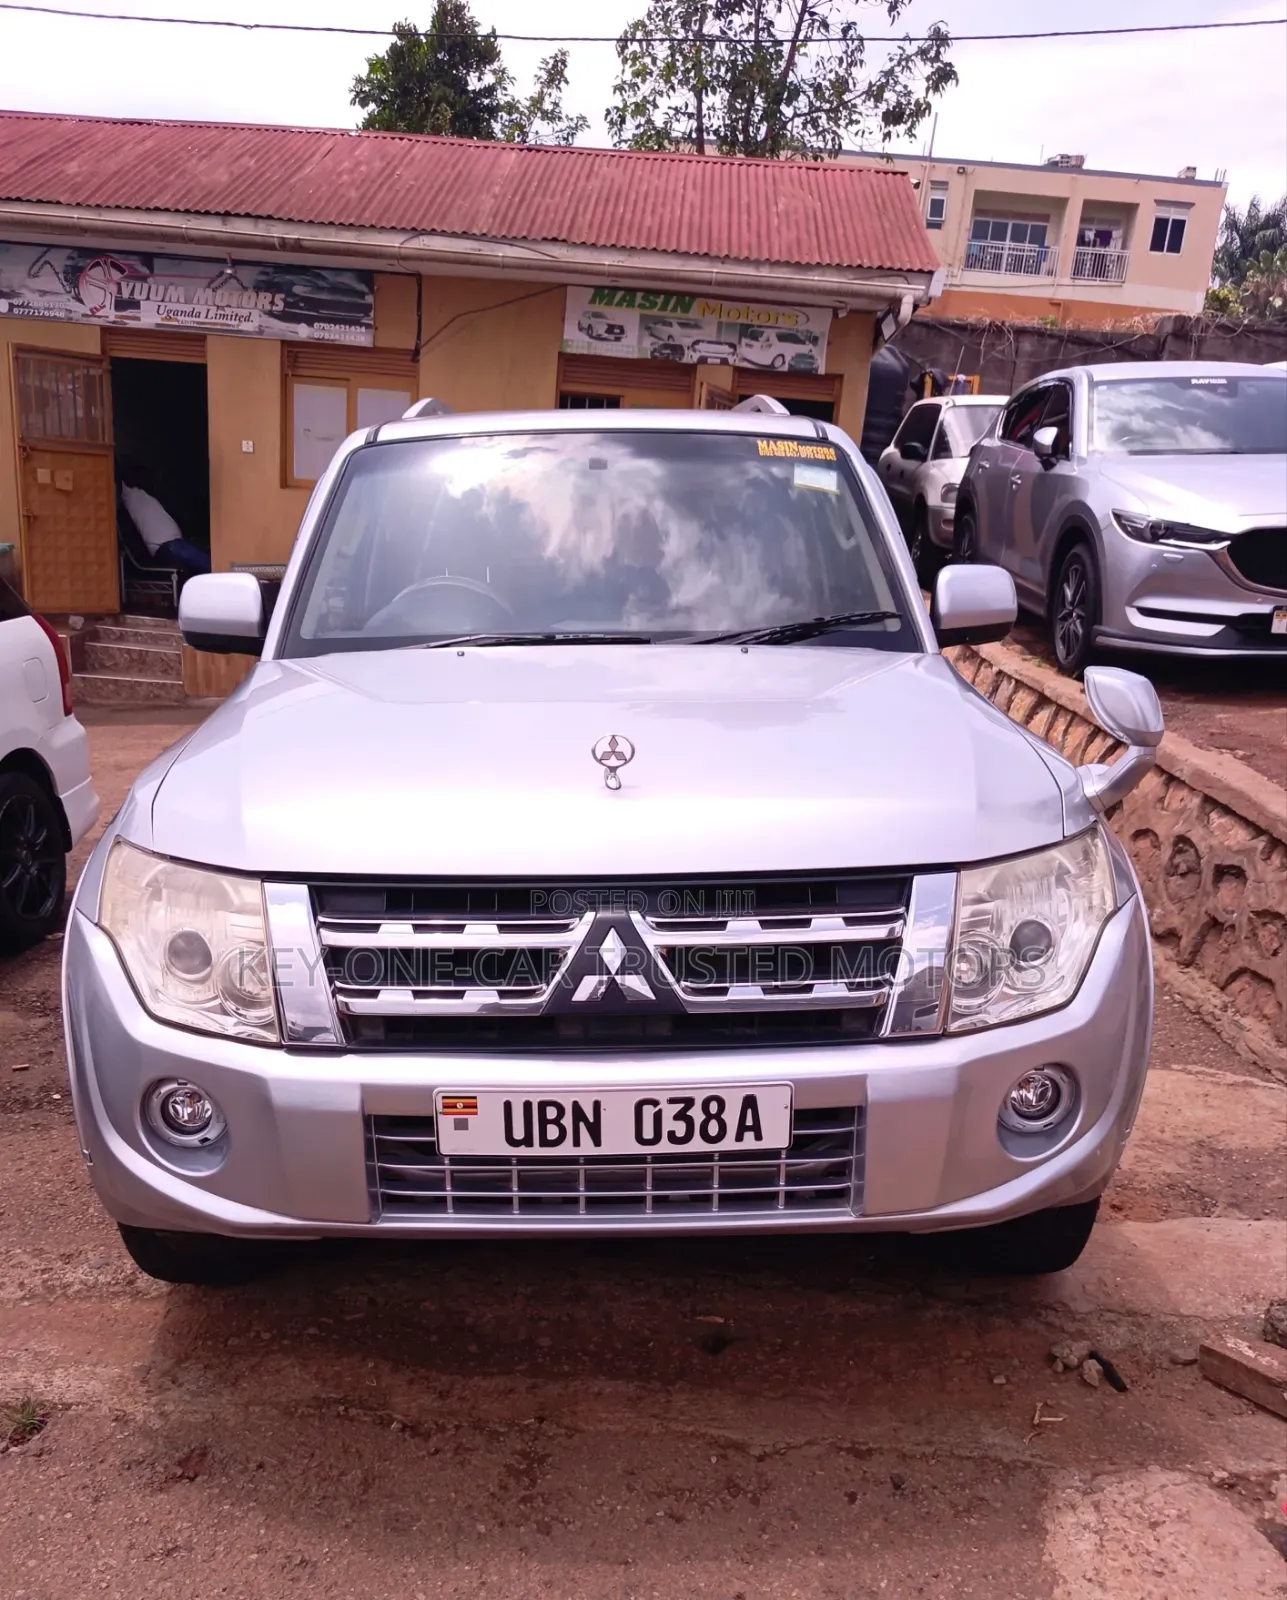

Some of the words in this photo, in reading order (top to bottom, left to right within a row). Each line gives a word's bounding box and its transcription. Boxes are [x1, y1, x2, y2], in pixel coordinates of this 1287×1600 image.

[193, 287, 286, 311] MOTORS
[588, 287, 696, 314] MASIN
[697, 299, 800, 327] Motors
[156, 304, 201, 320] Uganda
[204, 308, 254, 323] Limited.
[757, 440, 798, 452] MASIN
[798, 445, 835, 456] MOTORS
[503, 1098, 602, 1148] UBN
[634, 1093, 764, 1147] 038A
